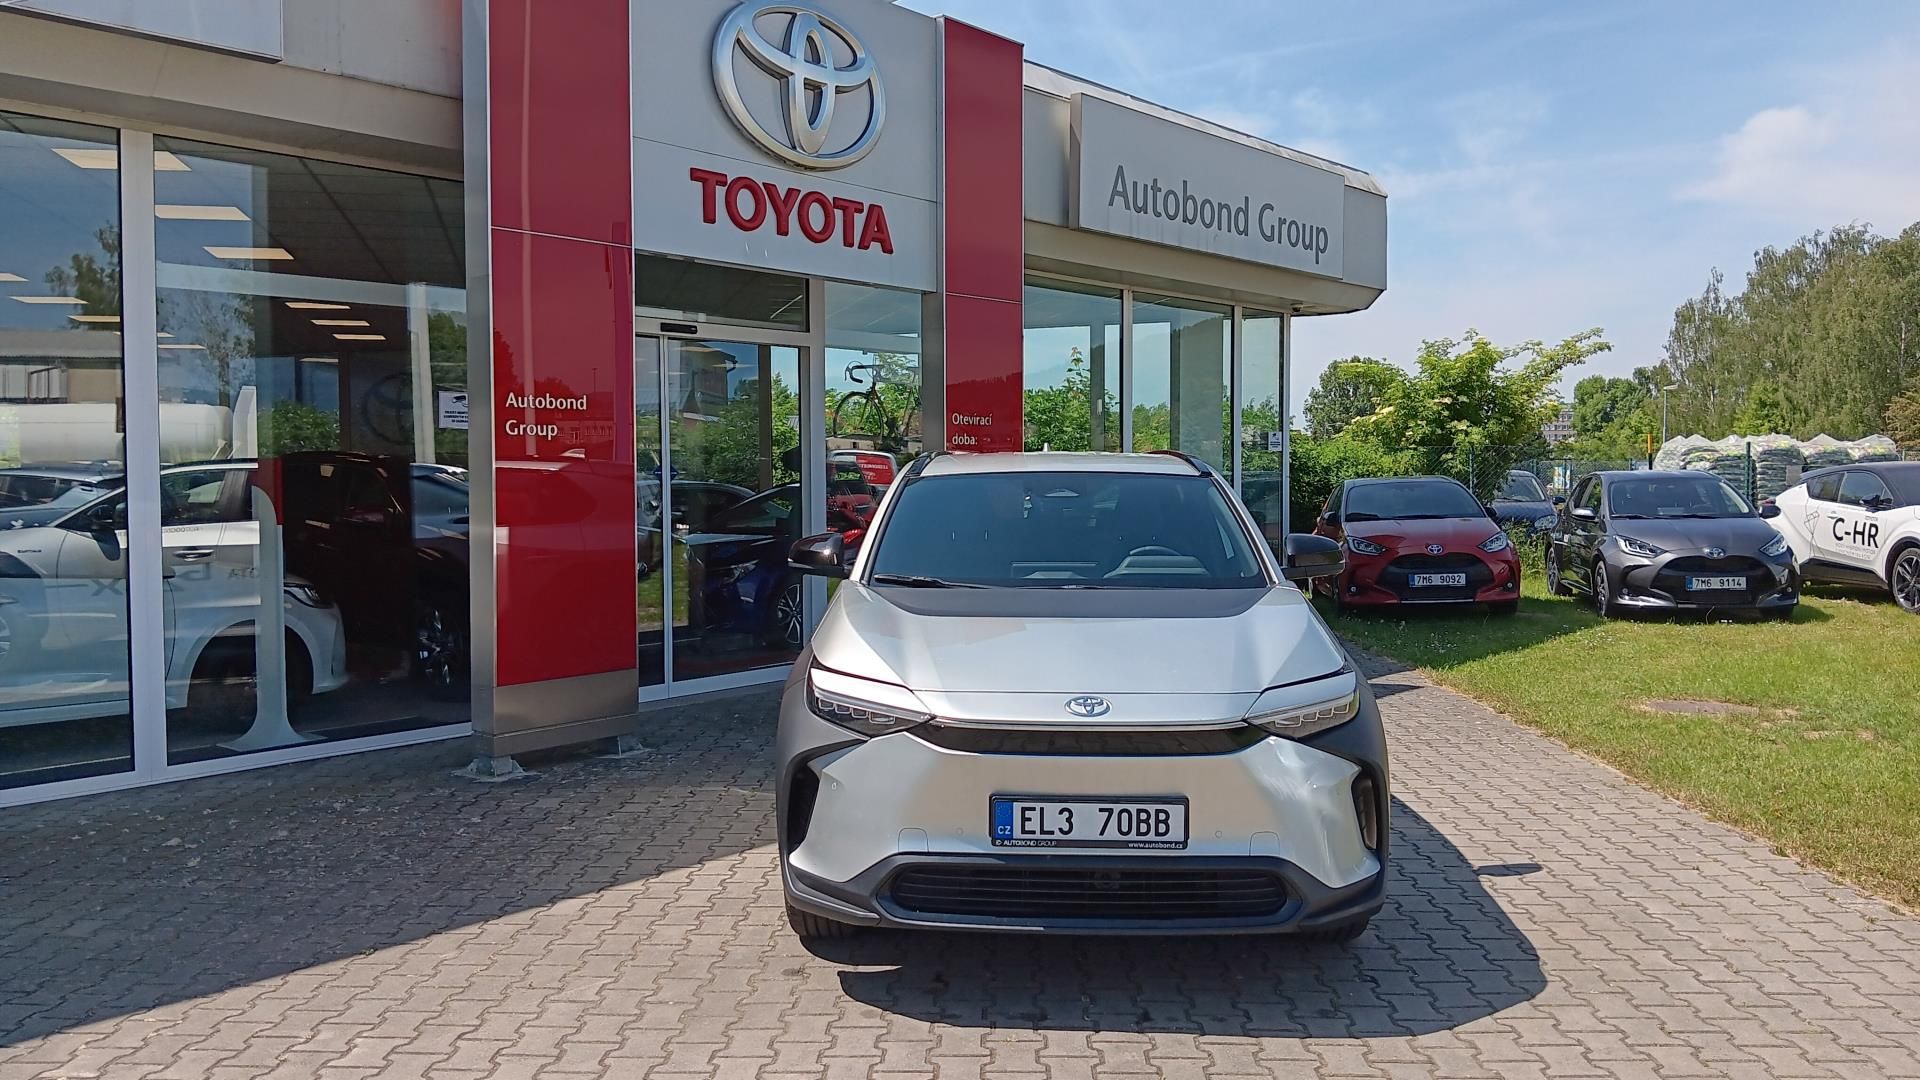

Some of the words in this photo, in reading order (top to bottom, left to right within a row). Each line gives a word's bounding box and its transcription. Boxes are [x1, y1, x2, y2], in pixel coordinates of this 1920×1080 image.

[689, 167, 894, 255] TOYOTA
[1108, 164, 1249, 237] Autobond
[1258, 203, 1329, 264] Group
[505, 391, 587, 410] Autobond
[952, 412, 993, 425] Otevírací
[505, 419, 558, 440] Group
[952, 433, 978, 445] doba:
[1832, 517, 1879, 549] C-HR
[1416, 575, 1433, 584] 7M6
[1439, 574, 1462, 584] 9092
[1694, 578, 1712, 588] 7M6
[1719, 578, 1742, 587] 9114
[997, 825, 1011, 835] CZ
[1021, 806, 1074, 836] EL3
[1098, 807, 1171, 837] 70BB
